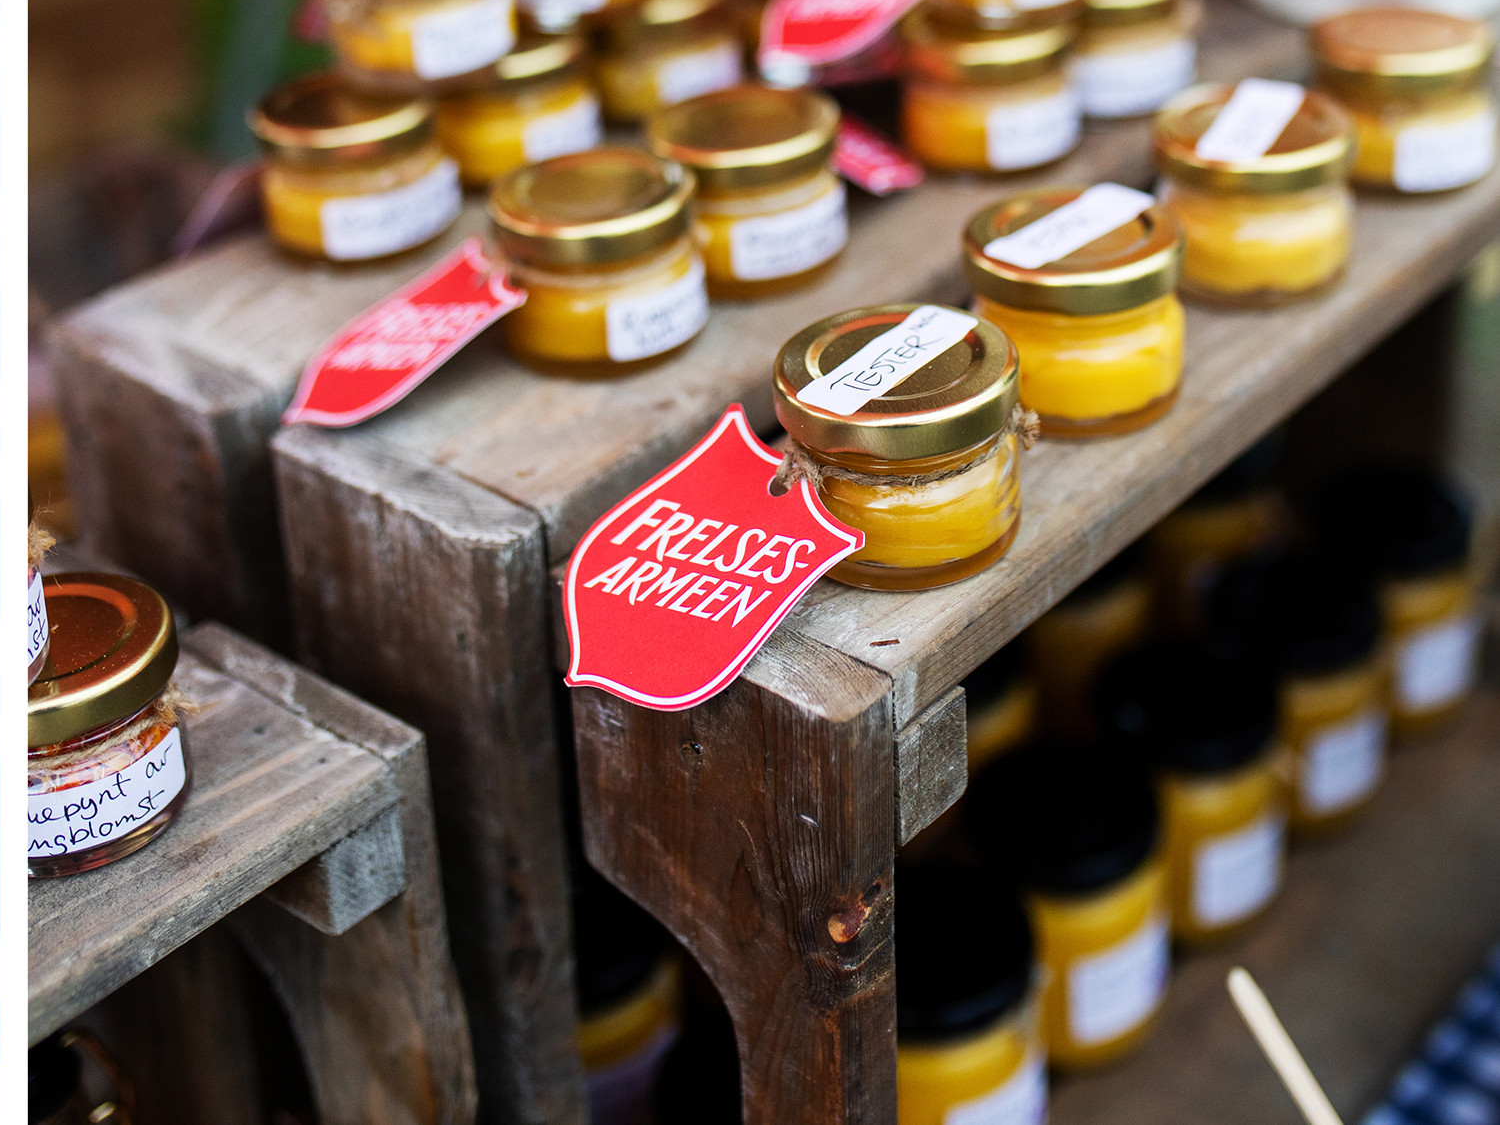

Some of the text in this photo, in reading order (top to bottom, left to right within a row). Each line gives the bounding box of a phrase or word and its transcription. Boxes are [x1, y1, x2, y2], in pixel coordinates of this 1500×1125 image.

[829, 335, 946, 392] TESTER
[610, 498, 817, 584] FRELSES-
[583, 556, 773, 628] ARMEEN
